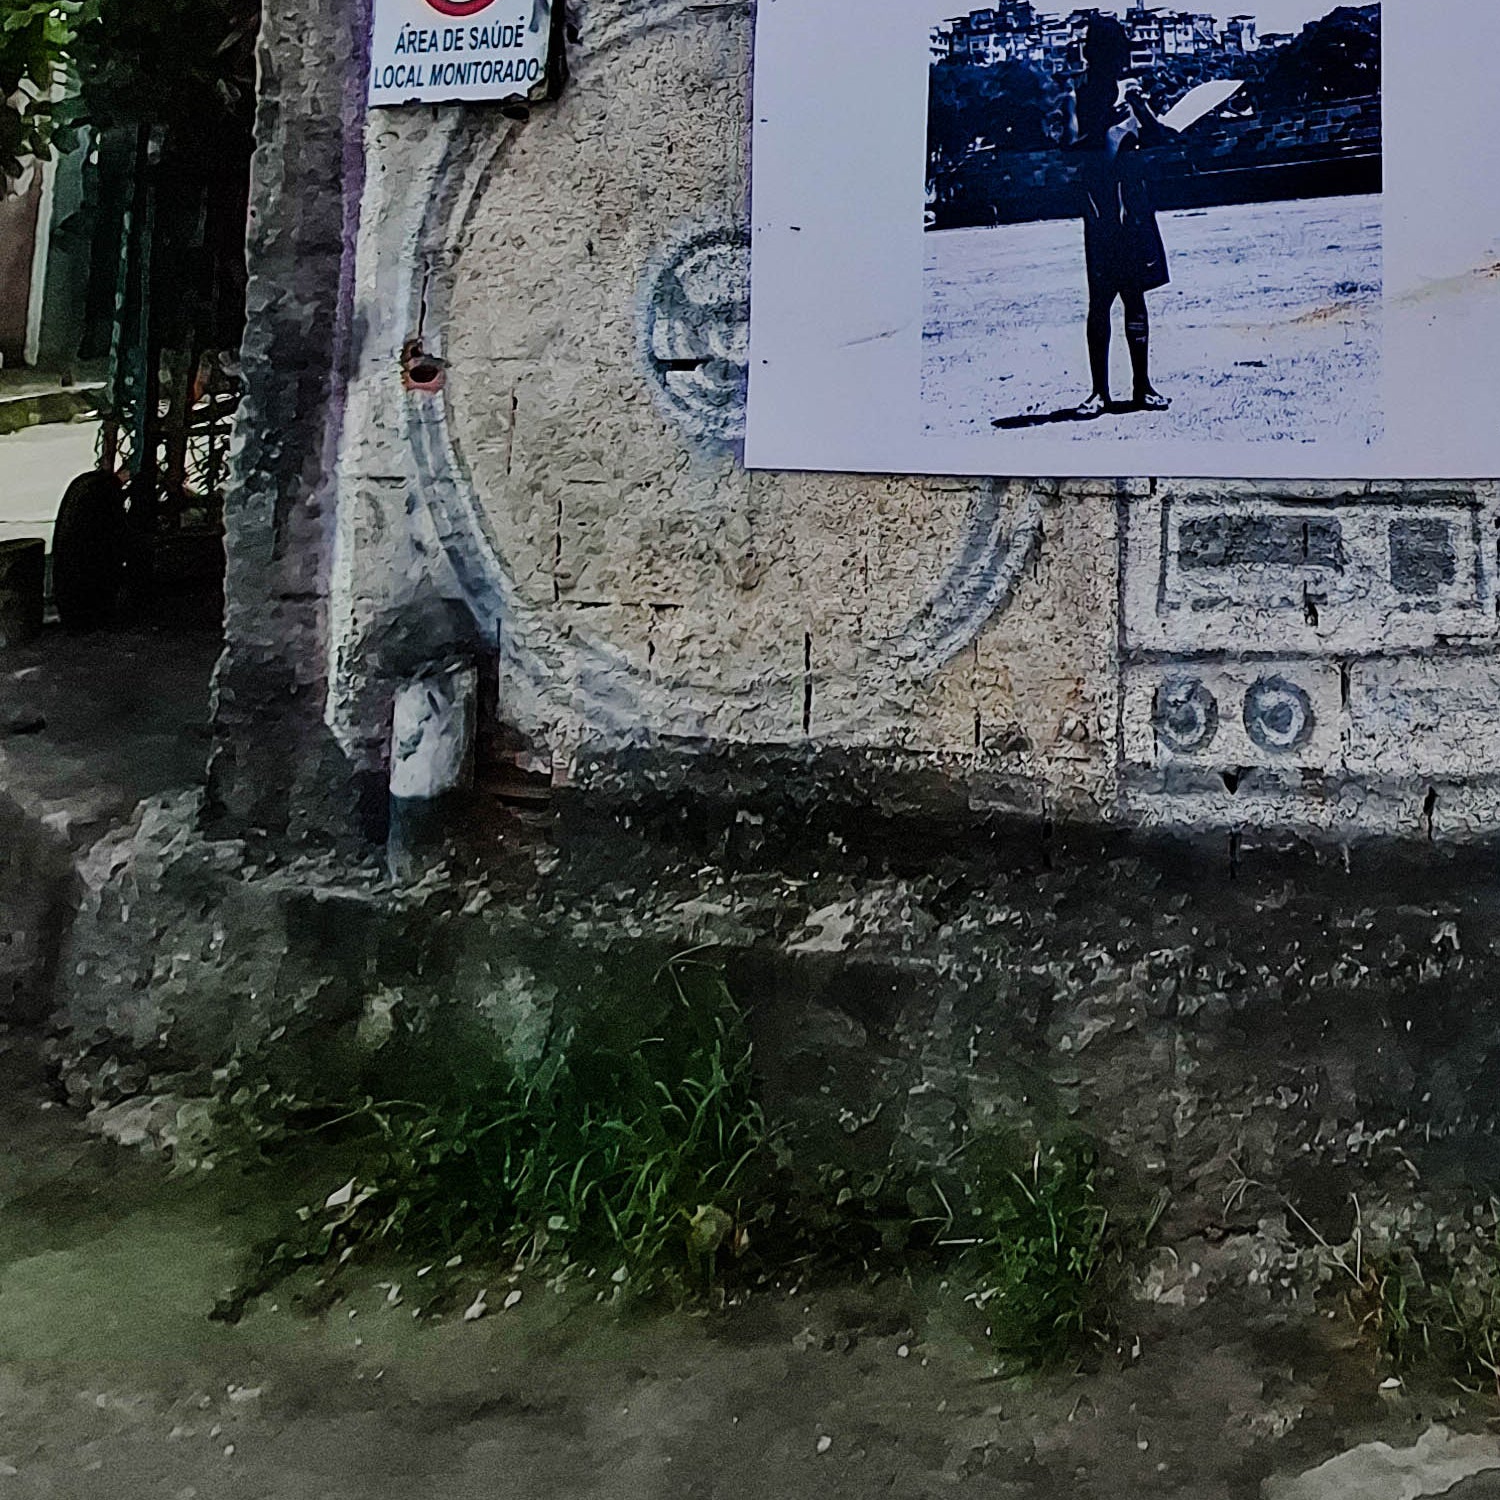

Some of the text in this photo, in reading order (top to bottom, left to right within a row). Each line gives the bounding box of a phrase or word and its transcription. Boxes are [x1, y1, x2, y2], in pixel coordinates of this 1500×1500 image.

[395, 21, 524, 54] ÁREA DE SAÚDE
[374, 58, 539, 88] LOCAL MONITORADO
